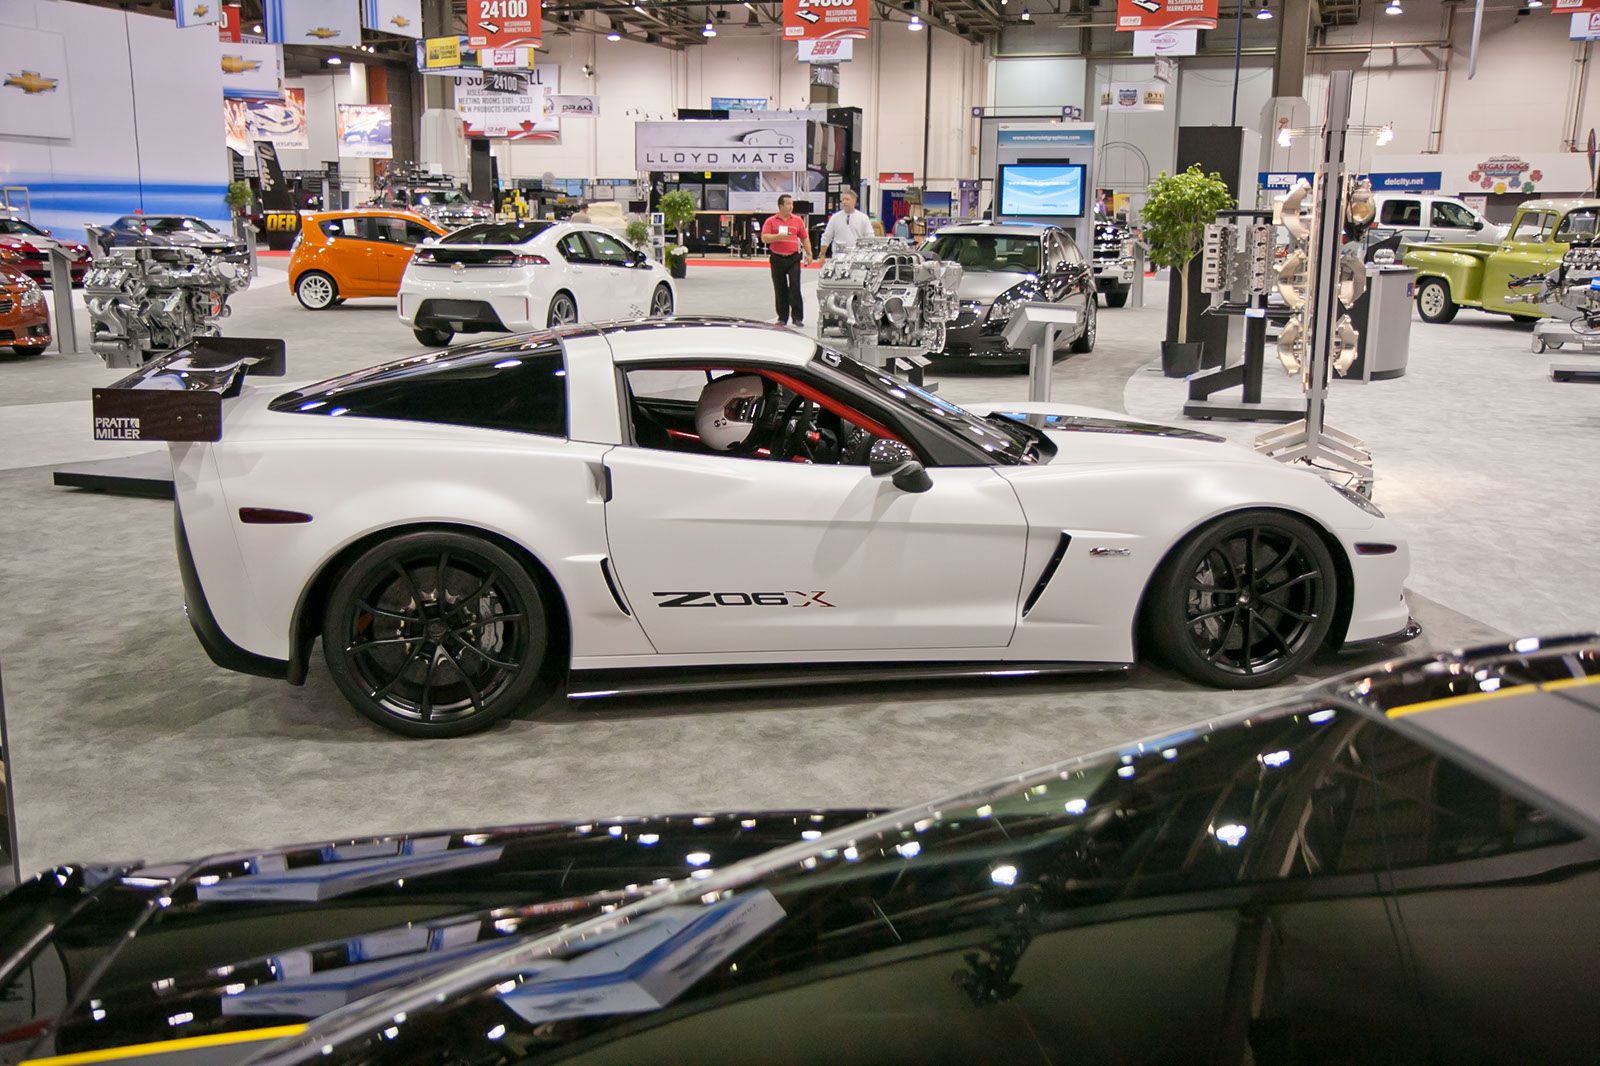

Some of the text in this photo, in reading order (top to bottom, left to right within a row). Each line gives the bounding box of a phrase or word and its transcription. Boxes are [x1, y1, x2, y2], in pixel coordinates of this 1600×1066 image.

[480, 0, 528, 19] 24100
[815, 41, 841, 49] SUPER
[494, 54, 516, 63] CAR
[493, 74, 518, 91] 24100
[646, 153, 795, 164] LLOYD MATS
[1385, 177, 1424, 187] delcity.net
[95, 418, 130, 428] PRATT
[96, 428, 140, 439] MILLER
